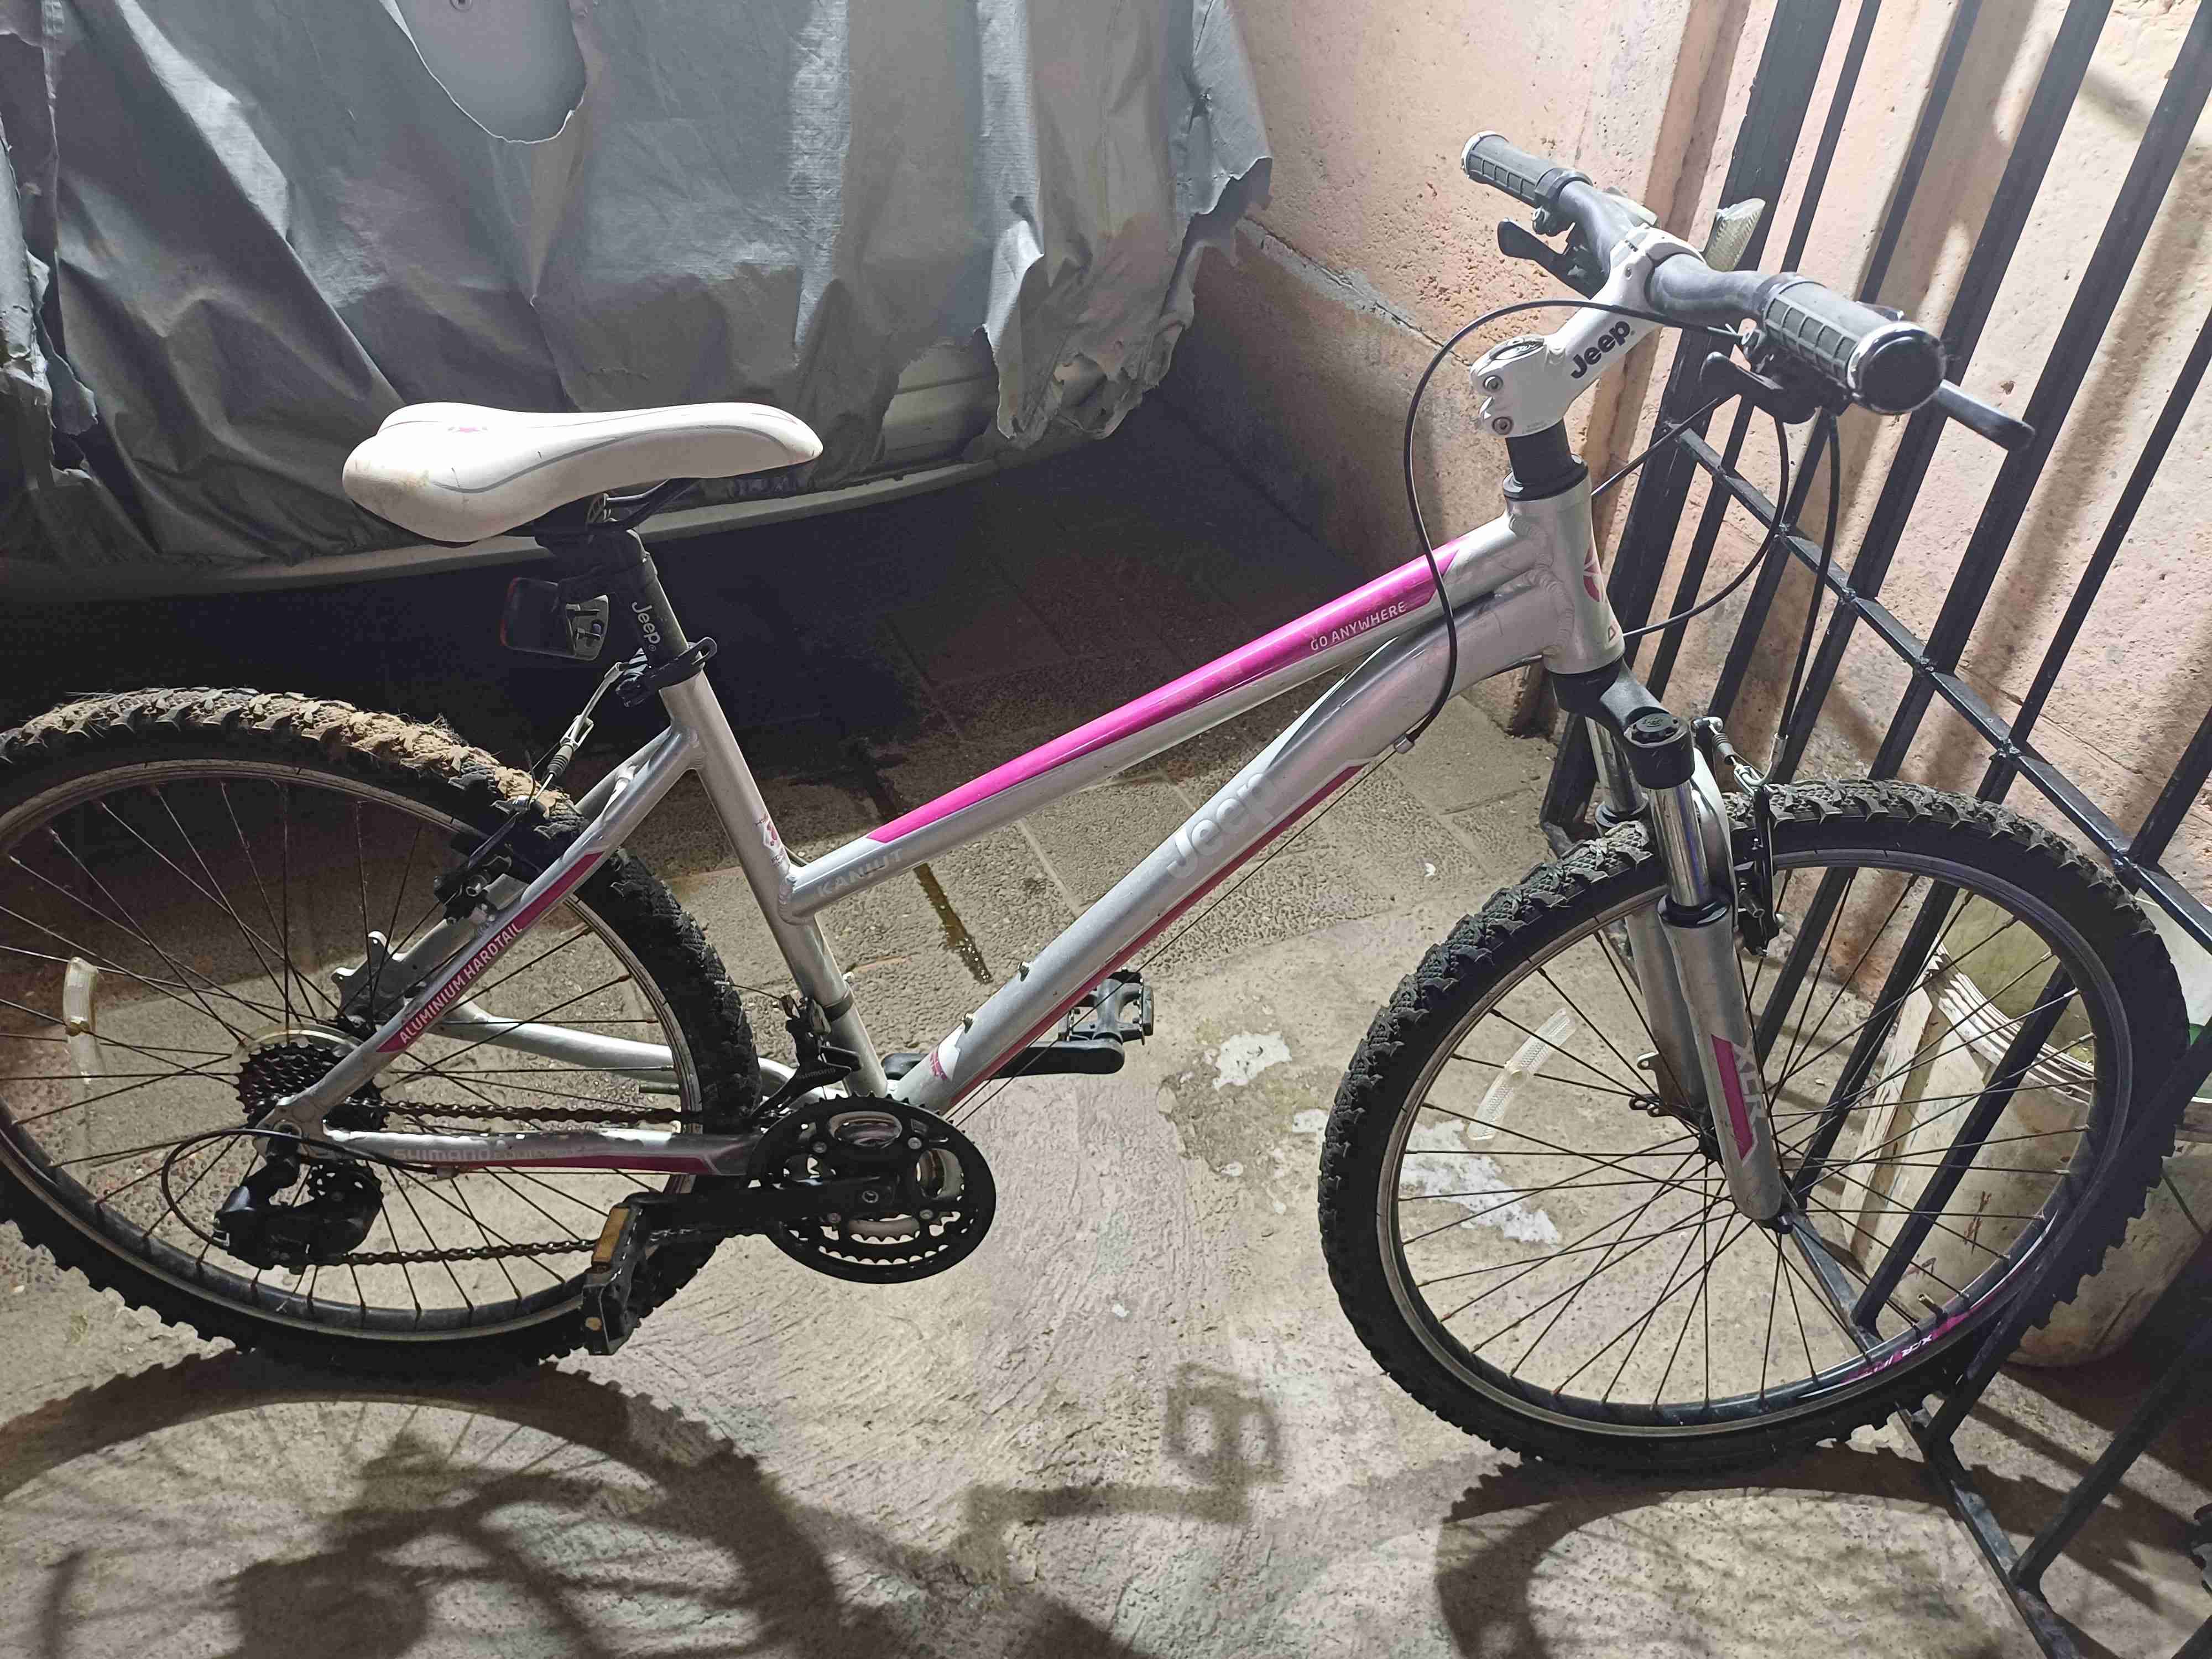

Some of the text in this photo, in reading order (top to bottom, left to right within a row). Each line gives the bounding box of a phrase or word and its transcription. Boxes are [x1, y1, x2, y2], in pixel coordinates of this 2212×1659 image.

[1570, 320, 1631, 379] Jeep
[631, 601, 661, 645] Jeep
[1310, 601, 1407, 652] GO ANYWHERE
[398, 922, 524, 1045] ALUMINIUM HARDTAIL
[393, 1149, 492, 1161] SHIMANO
